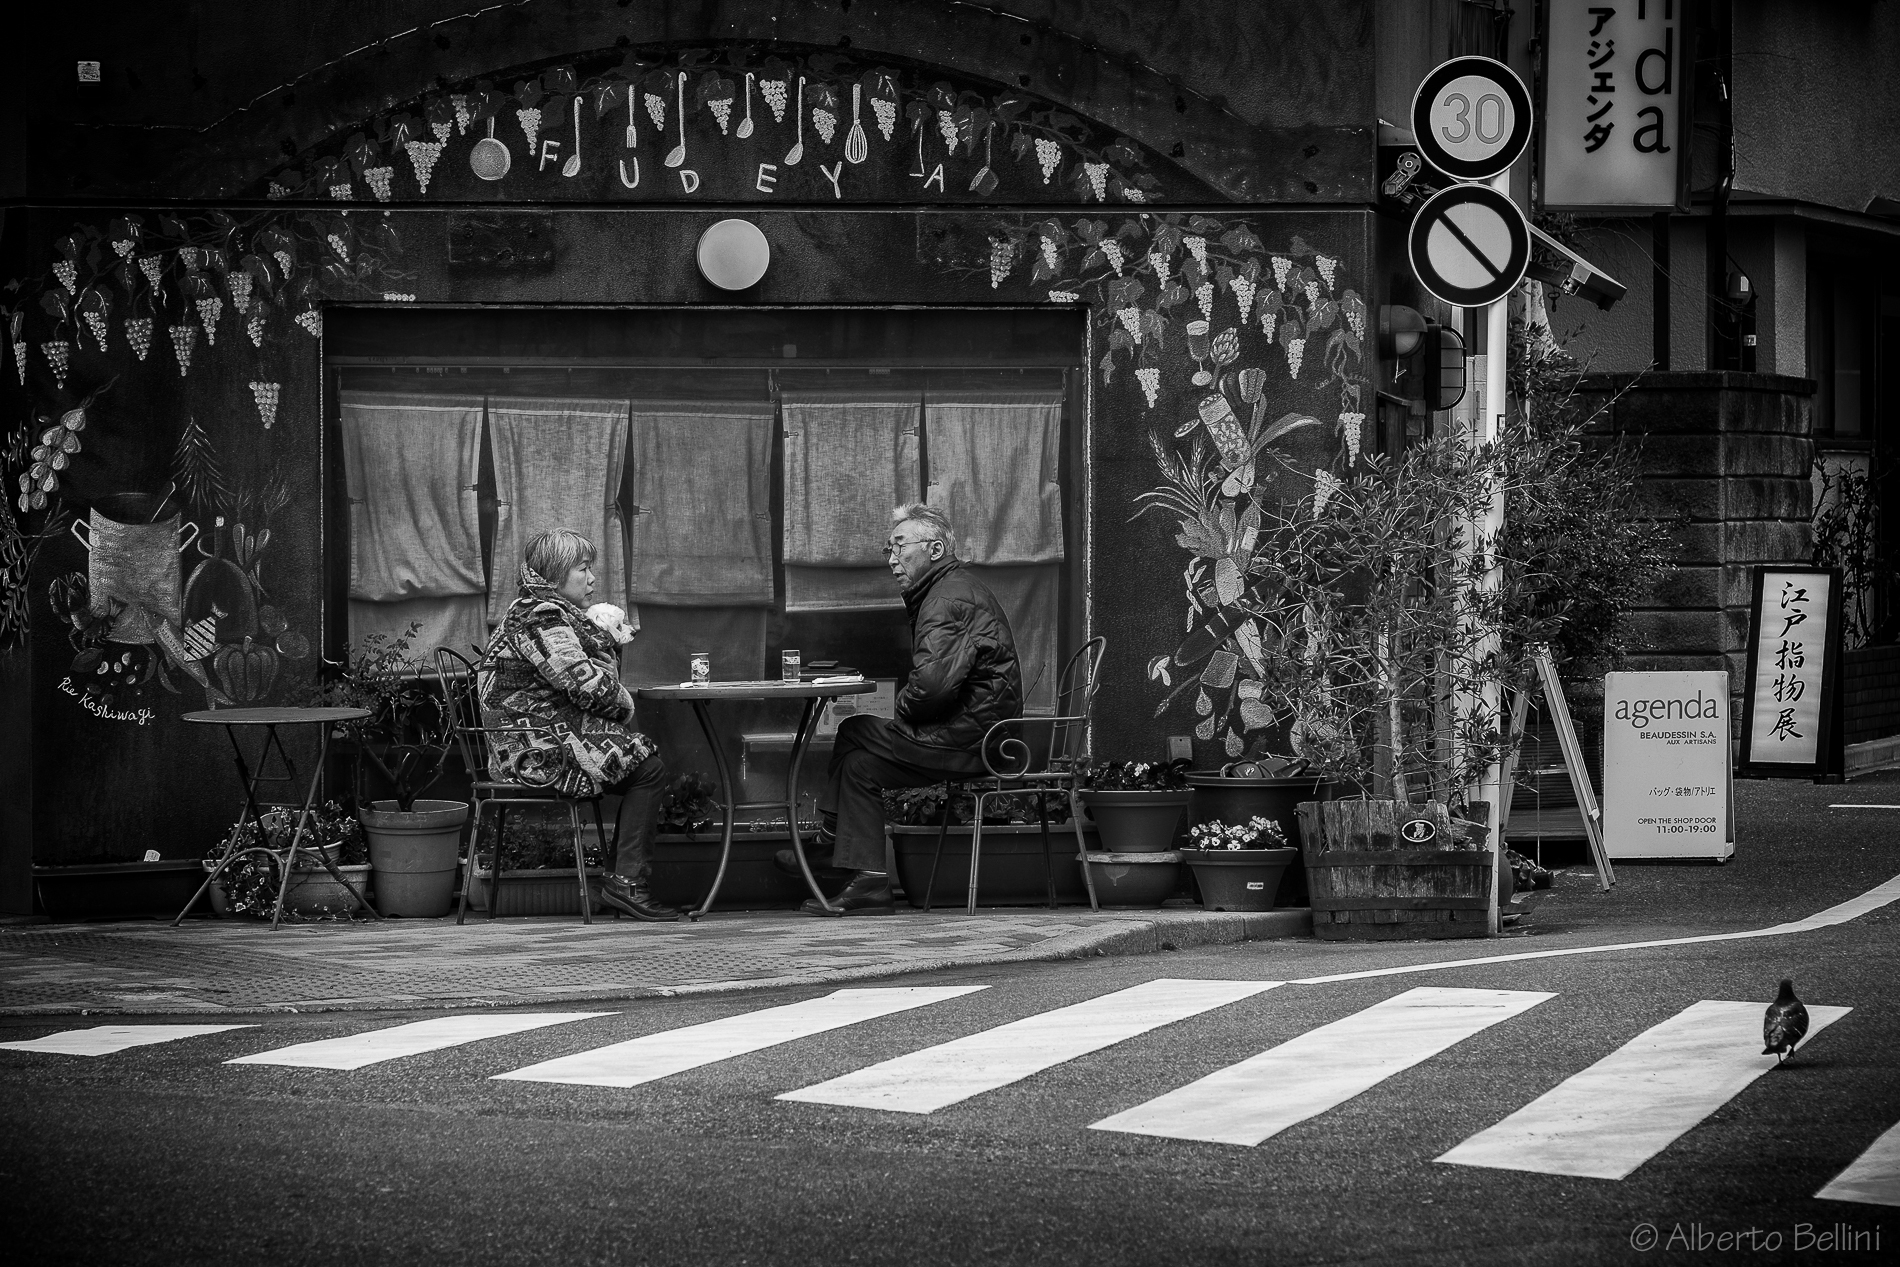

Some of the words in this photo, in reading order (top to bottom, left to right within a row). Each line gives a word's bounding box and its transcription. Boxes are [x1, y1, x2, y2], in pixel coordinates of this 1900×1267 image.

[1583, 7, 1617, 154] アジェンダ
[1441, 92, 1506, 145] 30
[1766, 581, 1811, 742] 江戸指物展
[57, 675, 79, 696] Rie
[1614, 689, 1720, 729] agenda
[1640, 731, 1697, 740] BEAUDESSIN
[1700, 730, 1717, 739] S.A.
[1637, 817, 1657, 825] OPEN
[1656, 824, 1717, 834] 11:00-19:00
